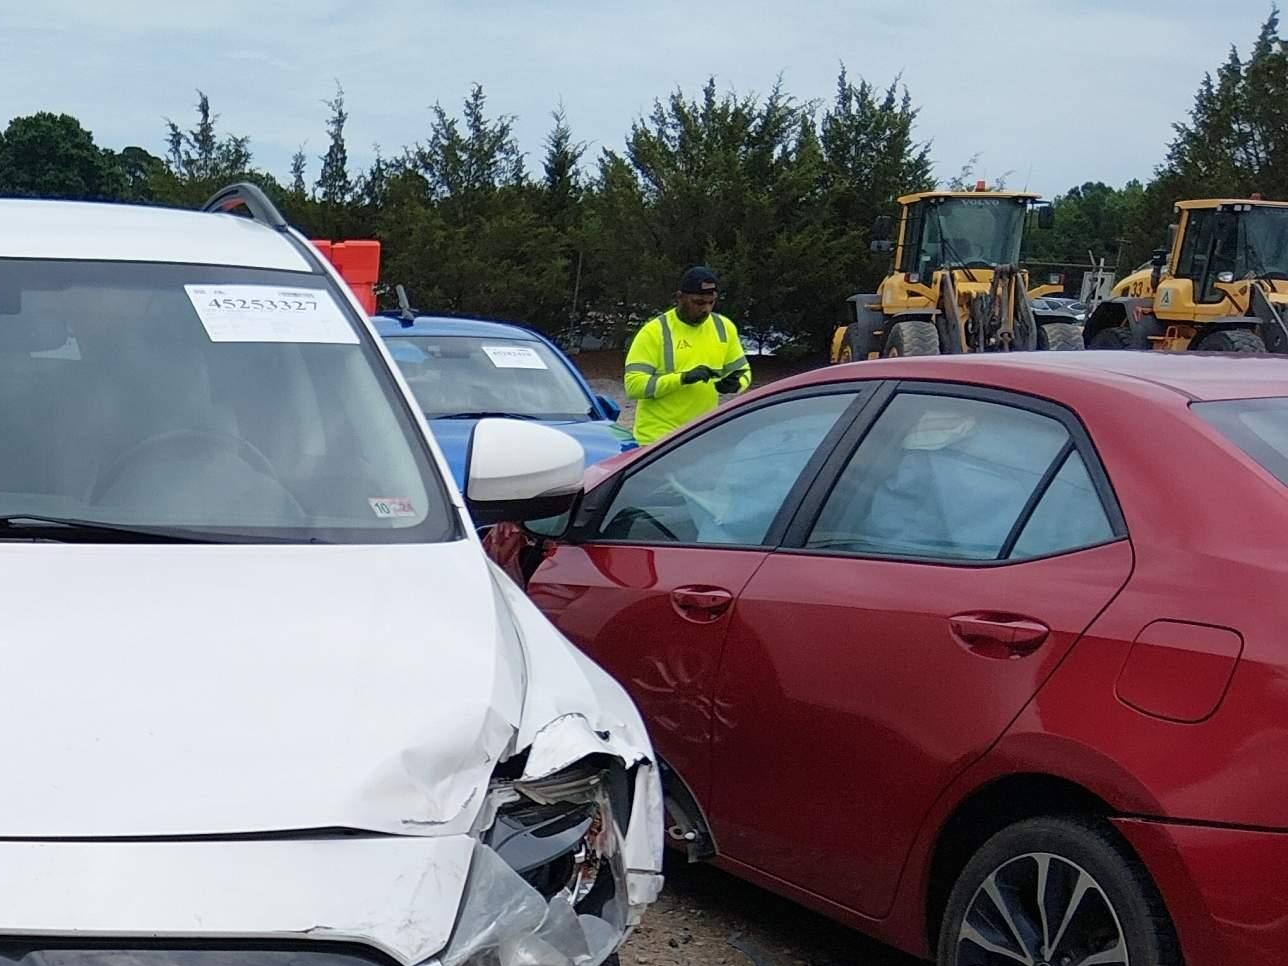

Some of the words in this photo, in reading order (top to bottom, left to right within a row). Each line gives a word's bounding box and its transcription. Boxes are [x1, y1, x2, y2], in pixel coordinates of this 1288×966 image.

[961, 199, 1000, 207] VOLVO
[1131, 281, 1143, 297] 33
[208, 298, 318, 311] 45253327
[375, 502, 390, 514] 10
